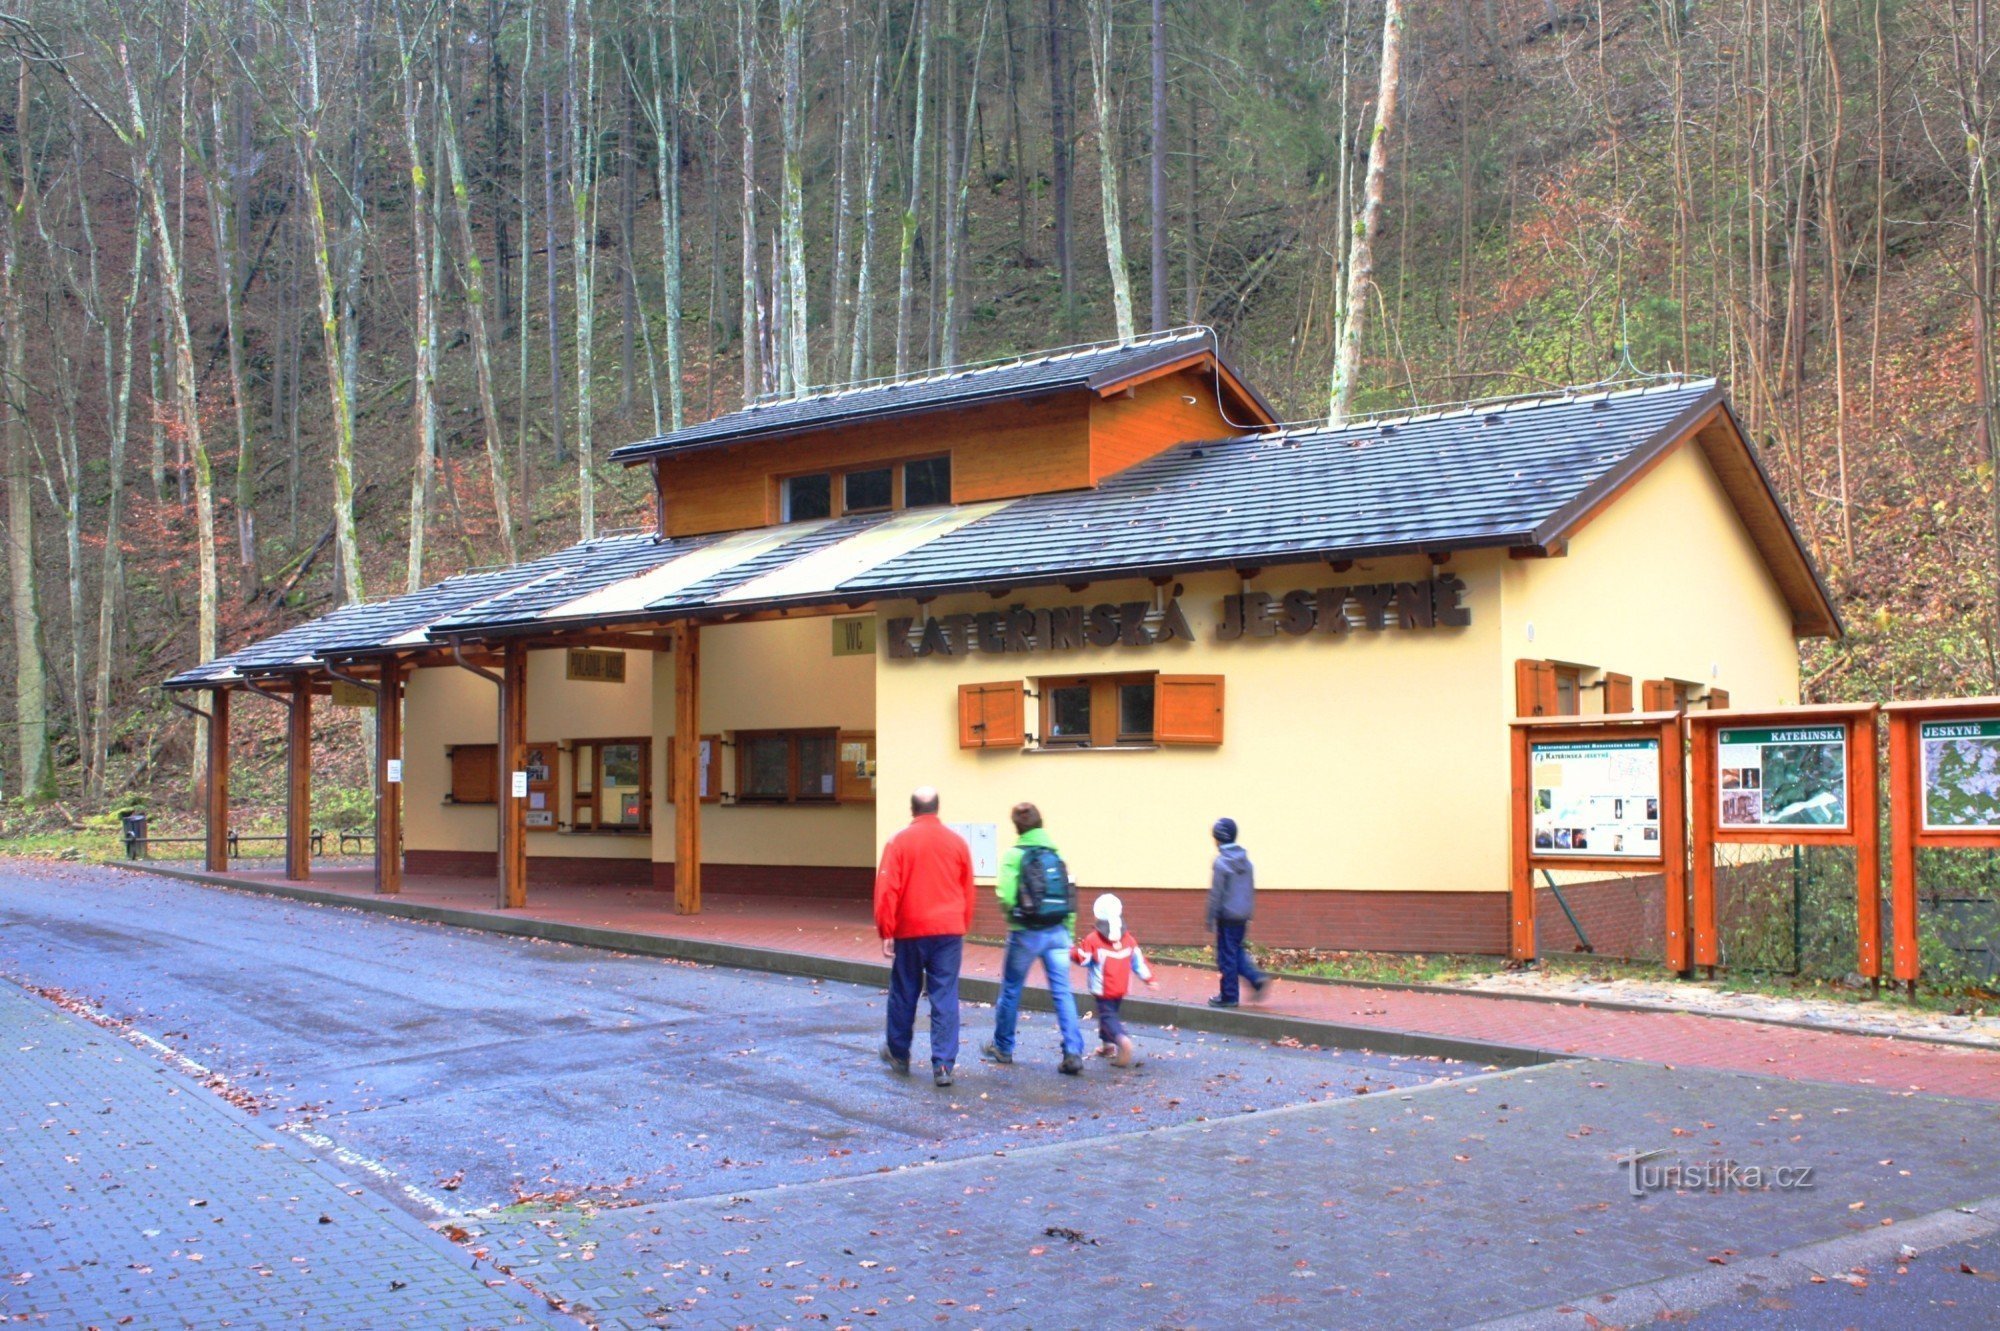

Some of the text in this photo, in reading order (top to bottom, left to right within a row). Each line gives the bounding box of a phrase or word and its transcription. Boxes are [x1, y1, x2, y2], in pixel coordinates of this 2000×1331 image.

[887, 573, 1472, 659] KATEŘINSKÁ JESKYNĚ
[846, 621, 863, 651] WC
[1771, 728, 1843, 742] KATEŘINSKÁ
[1923, 723, 1981, 737] JESKYNĚ
